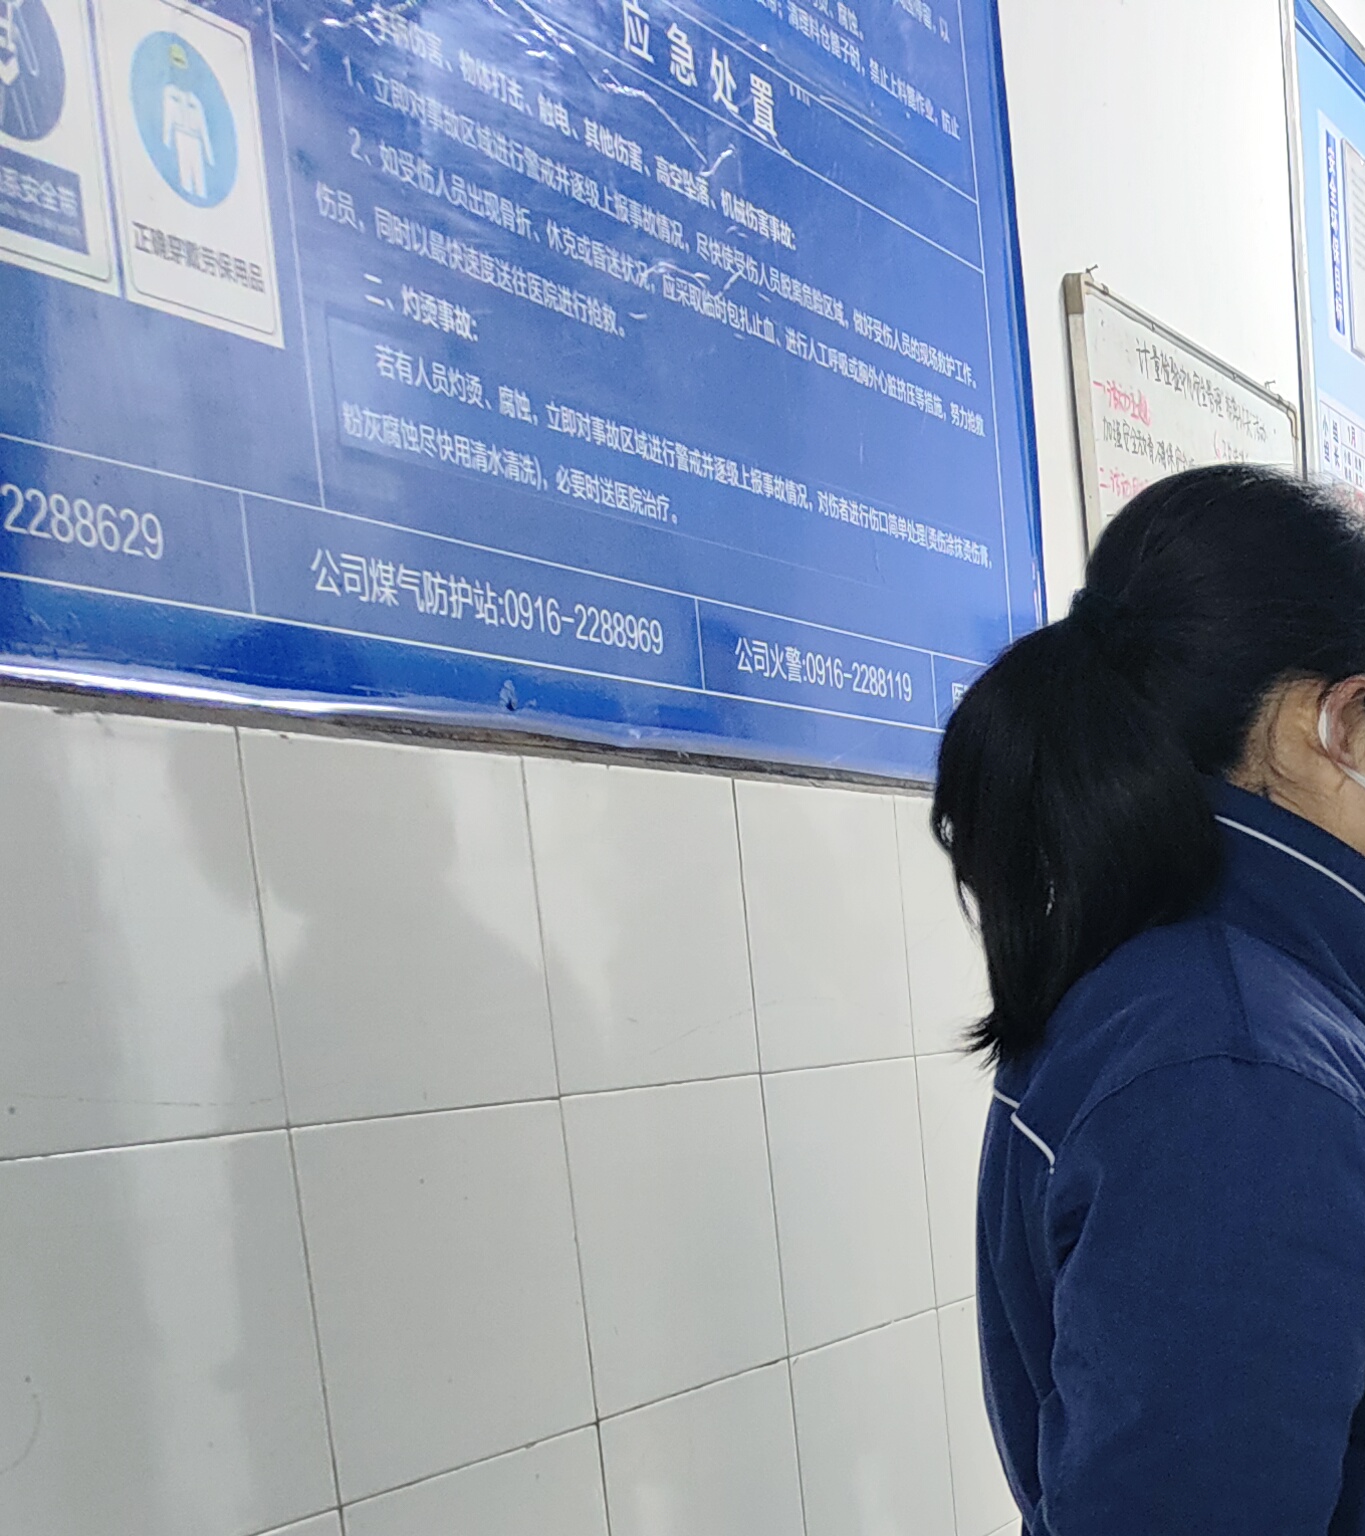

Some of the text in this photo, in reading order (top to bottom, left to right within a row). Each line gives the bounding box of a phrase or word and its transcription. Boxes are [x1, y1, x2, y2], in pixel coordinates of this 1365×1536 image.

[622, 0, 778, 137] 应急处置
[1, 483, 164, 560] 2288629
